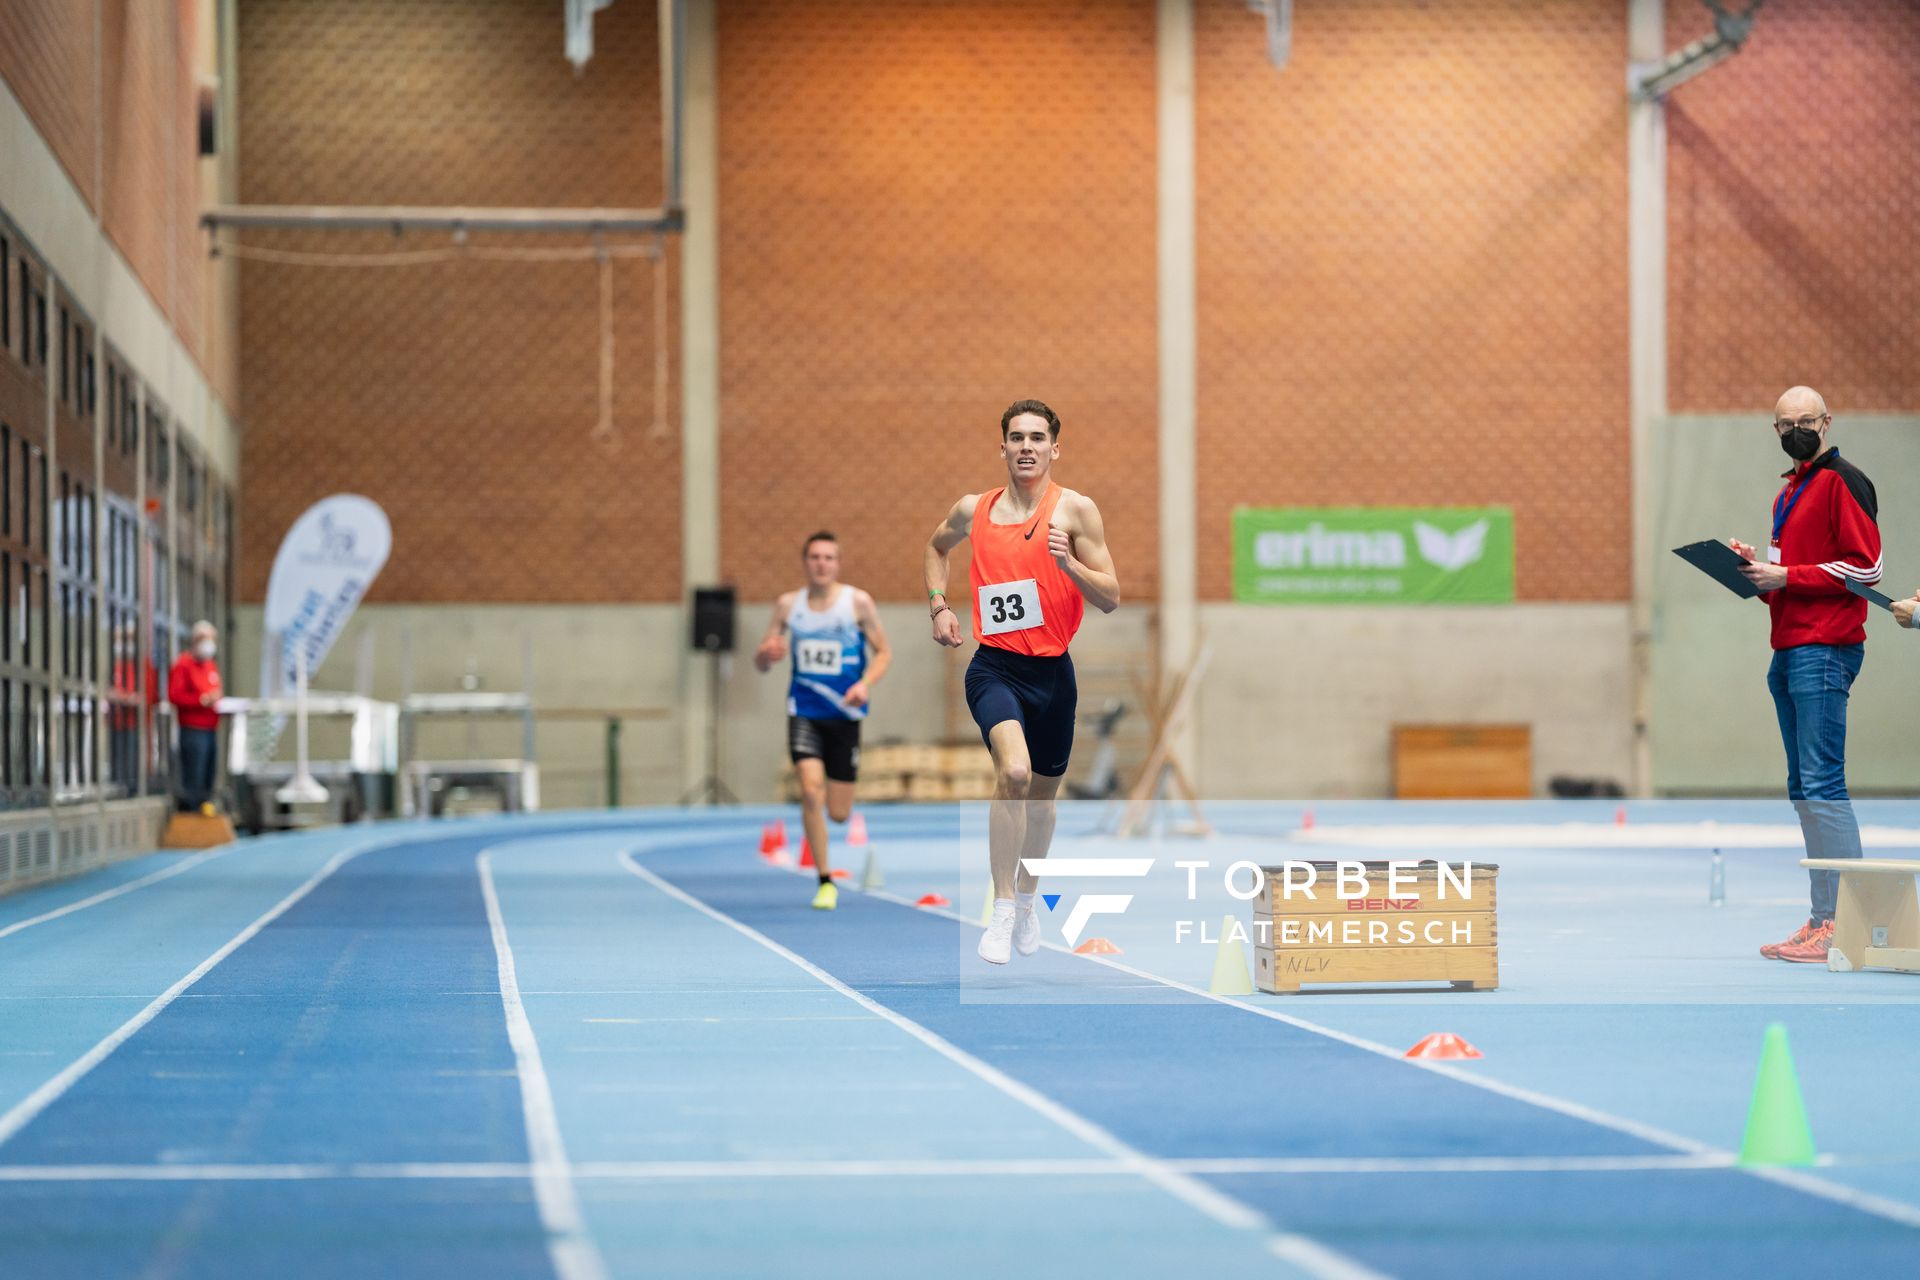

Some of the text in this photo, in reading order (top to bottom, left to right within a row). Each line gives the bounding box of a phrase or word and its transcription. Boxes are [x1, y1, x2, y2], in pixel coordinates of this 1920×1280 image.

[1255, 522, 1406, 568] erima
[990, 593, 1025, 623] 33
[803, 647, 836, 667] 142
[1286, 956, 1331, 975] NLV
